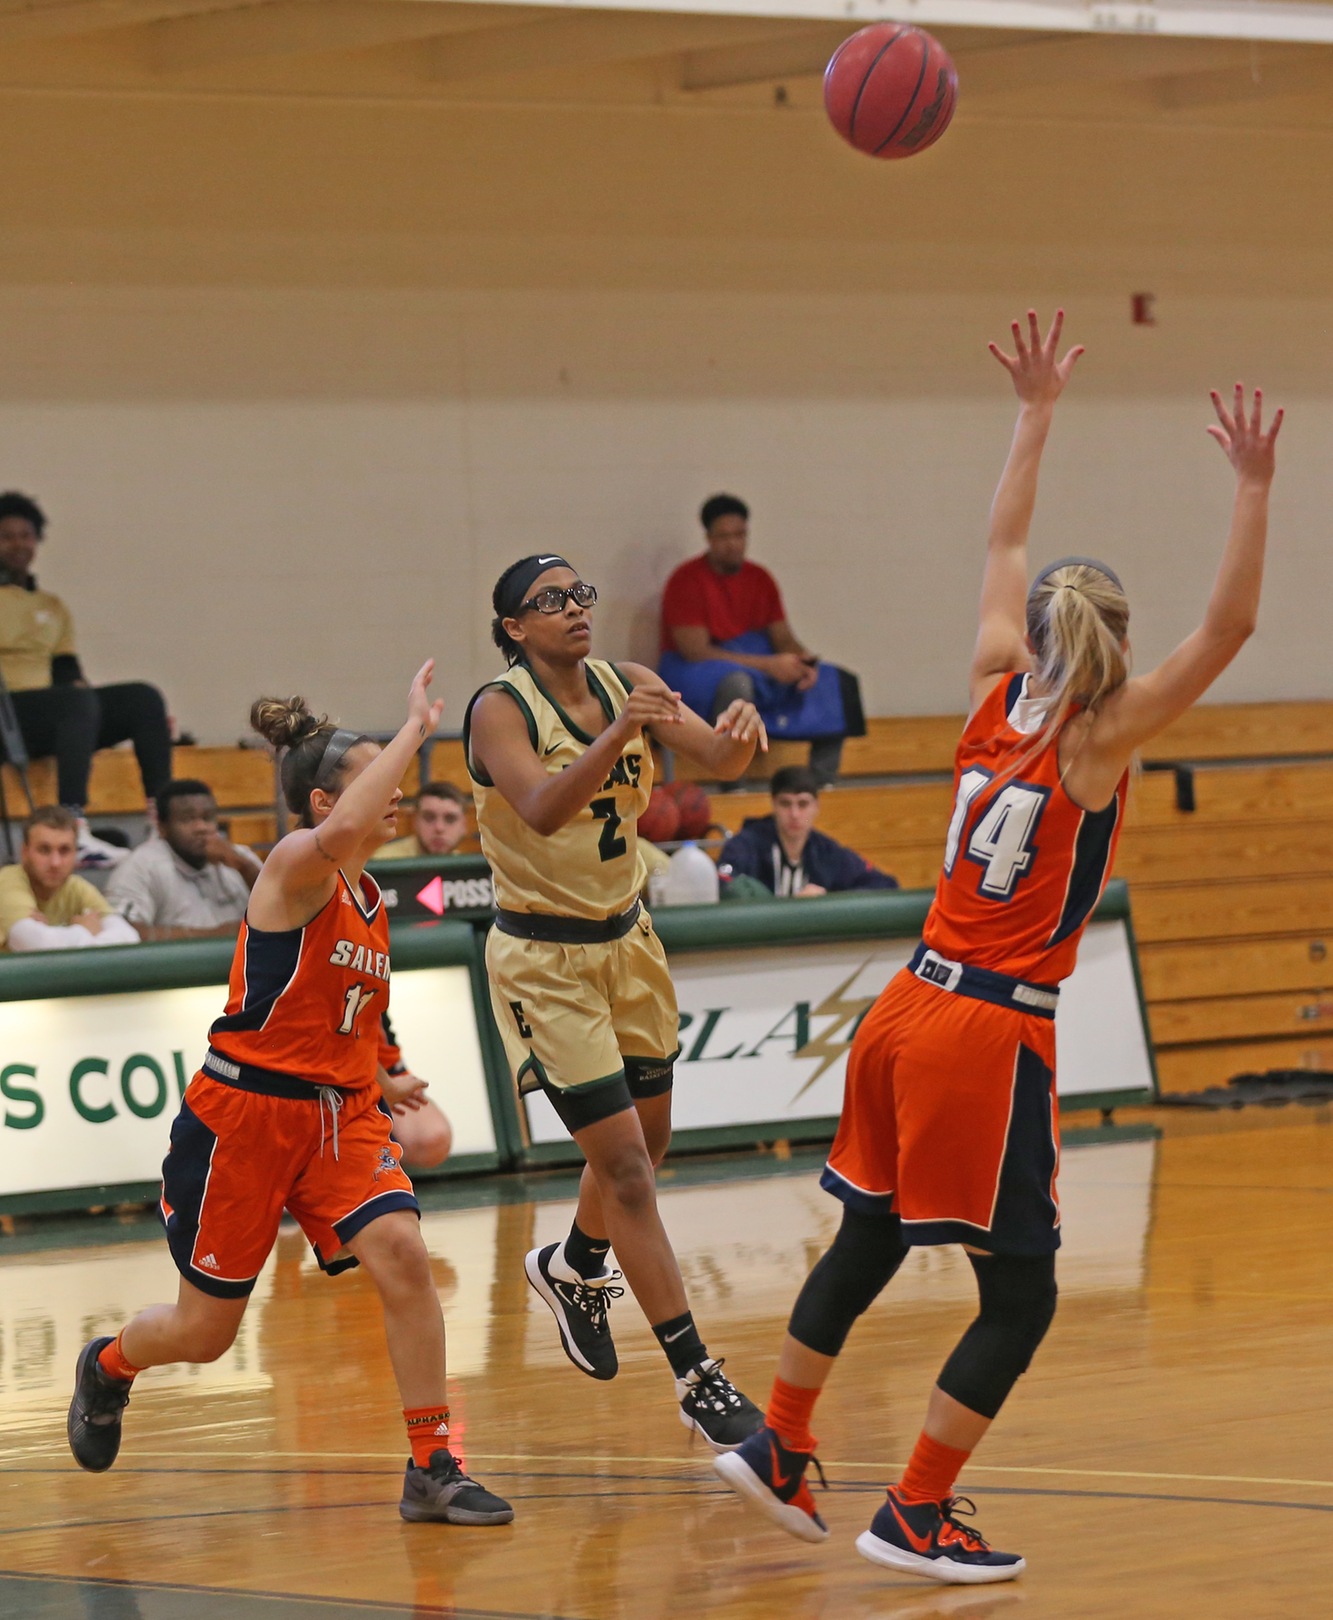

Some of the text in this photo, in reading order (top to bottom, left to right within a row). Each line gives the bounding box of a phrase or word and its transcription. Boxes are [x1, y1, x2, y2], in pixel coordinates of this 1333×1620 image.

[589, 796, 627, 862] 2
[944, 763, 1053, 903] 14
[442, 878, 498, 911] POSS
[509, 1001, 533, 1039] E
[0, 1063, 45, 1131] S
